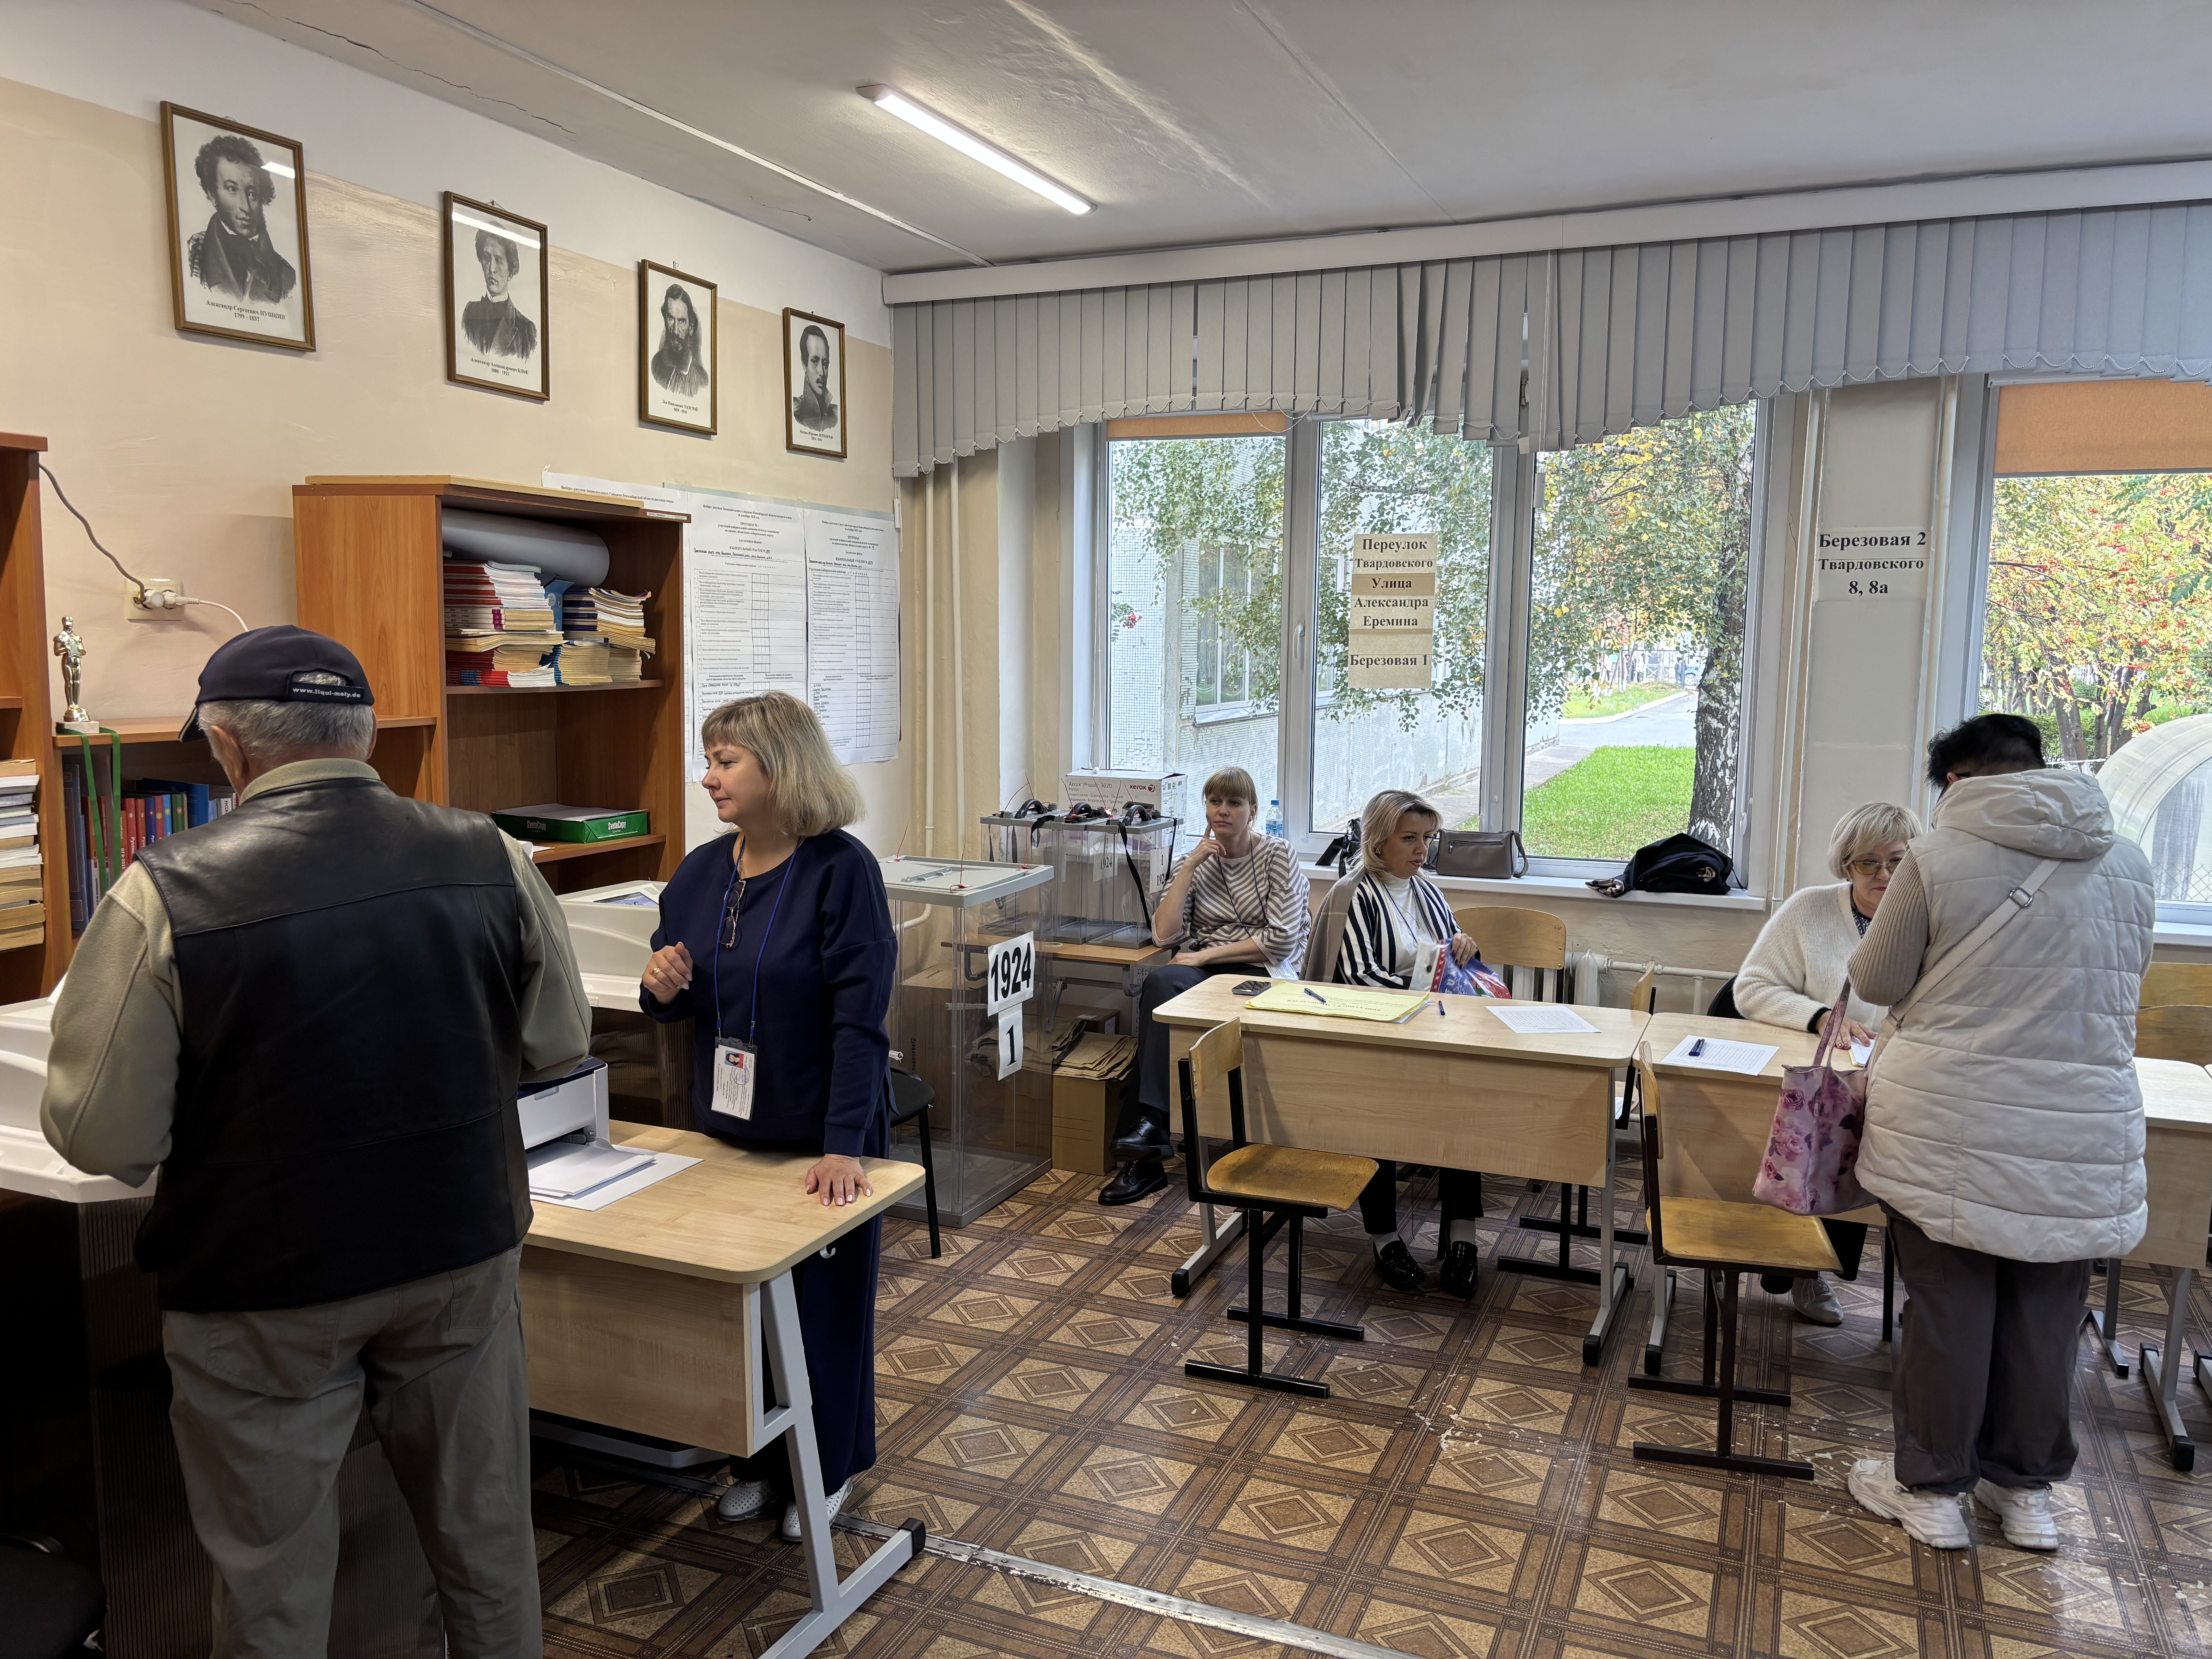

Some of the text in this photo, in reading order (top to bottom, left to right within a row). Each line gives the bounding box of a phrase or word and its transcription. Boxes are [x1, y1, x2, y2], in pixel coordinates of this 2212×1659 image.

[206, 300, 285, 320] Александр Сергеевич ПУШКИН
[1362, 538, 1428, 553] Переулок
[1819, 532, 1926, 550] Березовая 2
[1355, 558, 1433, 570] Твардовского
[1818, 559, 1924, 573] Твардовского
[1371, 578, 1412, 590] Улица
[1848, 580, 1888, 597] 8, 8а
[1354, 597, 1429, 610] Александра
[1363, 616, 1418, 629] Еремина
[1350, 654, 1428, 668] Березовая 1
[292, 687, 361, 698] www.liqui-moly.de
[527, 821, 546, 831] SvetoCopy
[608, 821, 626, 830] SvetoCopy
[1100, 855, 1113, 869] 1924
[991, 942, 1032, 1002] 1924
[1006, 1024, 1017, 1066] 1
